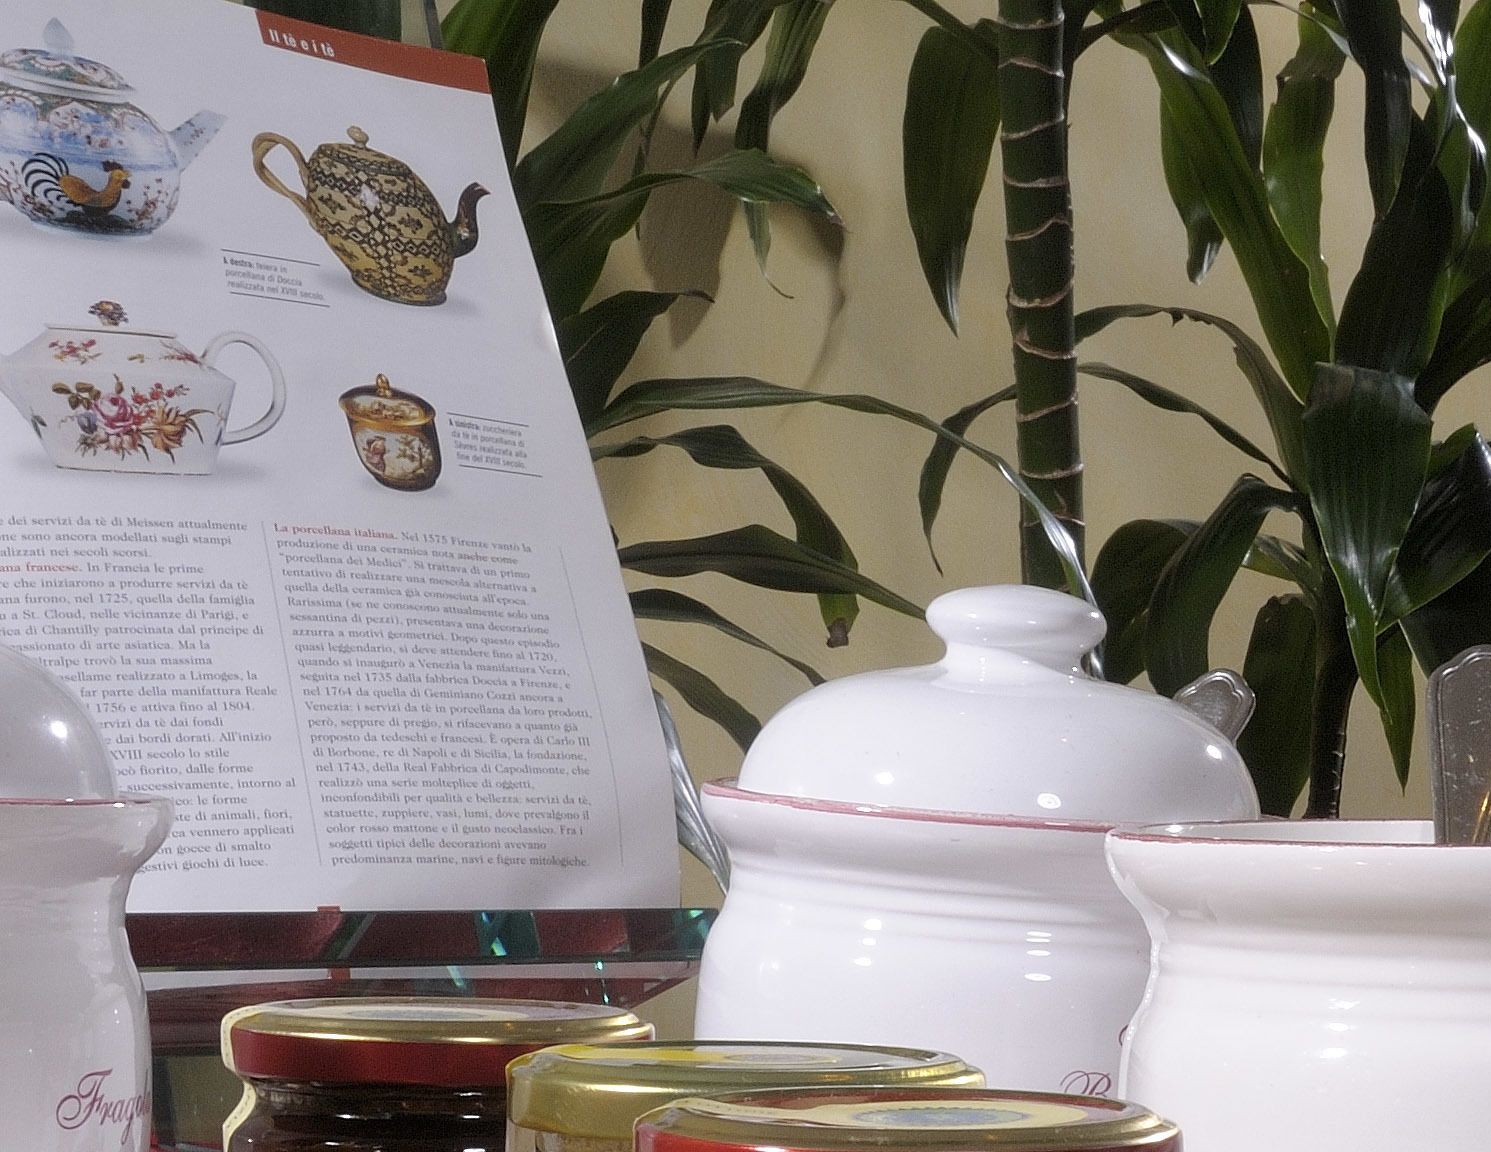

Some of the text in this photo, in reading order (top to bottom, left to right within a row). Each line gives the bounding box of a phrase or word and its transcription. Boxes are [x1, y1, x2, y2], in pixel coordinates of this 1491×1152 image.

[7, 515, 247, 530] dei servizi da tè di Meissen attualmente
[0, 545, 152, 557] alizzati nei secoli scorsi.
[25, 562, 204, 574] francese. In Francia le prime
[13, 578, 36, 588] che
[40, 579, 104, 588] iniziarono
[119, 580, 173, 590] produrre
[176, 580, 215, 588] servizi
[219, 579, 233, 589] da
[236, 581, 248, 589] tè
[24, 592, 255, 605] furono, nel 1725, quella della famiglia
[22, 609, 39, 619] St.
[43, 609, 85, 619] Cloud,
[89, 608, 119, 619] nelle
[123, 611, 181, 619] vicinanze
[184, 608, 197, 618] di
[200, 609, 238, 620] Parigi,
[25, 624, 264, 636] di Chantilly patrocinata dal principe di
[115, 671, 175, 680] realizzato
[189, 671, 243, 681] Limoges,
[246, 670, 257, 680] la
[80, 685, 277, 698] far parte della manifattura Reale
[96, 702, 126, 712] 1756
[141, 703, 176, 711] attiva
[179, 701, 203, 711] fino
[207, 701, 217, 711] al
[222, 701, 254, 710] 1804.
[115, 731, 271, 744] dai bordi dorati. All'inizio
[146, 749, 185, 759] secolo
[188, 747, 200, 758] lo
[204, 747, 229, 757] stile
[139, 763, 253, 775] fiorito, dalle forme
[126, 777, 295, 791] successivamente, intorno al
[194, 808, 292, 820] di animali, fiori,
[243, 825, 294, 837] applicati
[182, 858, 219, 870] giochi
[223, 857, 235, 867] di
[238, 856, 268, 867] luce.
[331, 855, 412, 865] predominanza
[415, 856, 458, 864] marine,
[461, 855, 484, 864] navi
[496, 854, 526, 866] figure
[529, 855, 589, 867] mitologiche.
